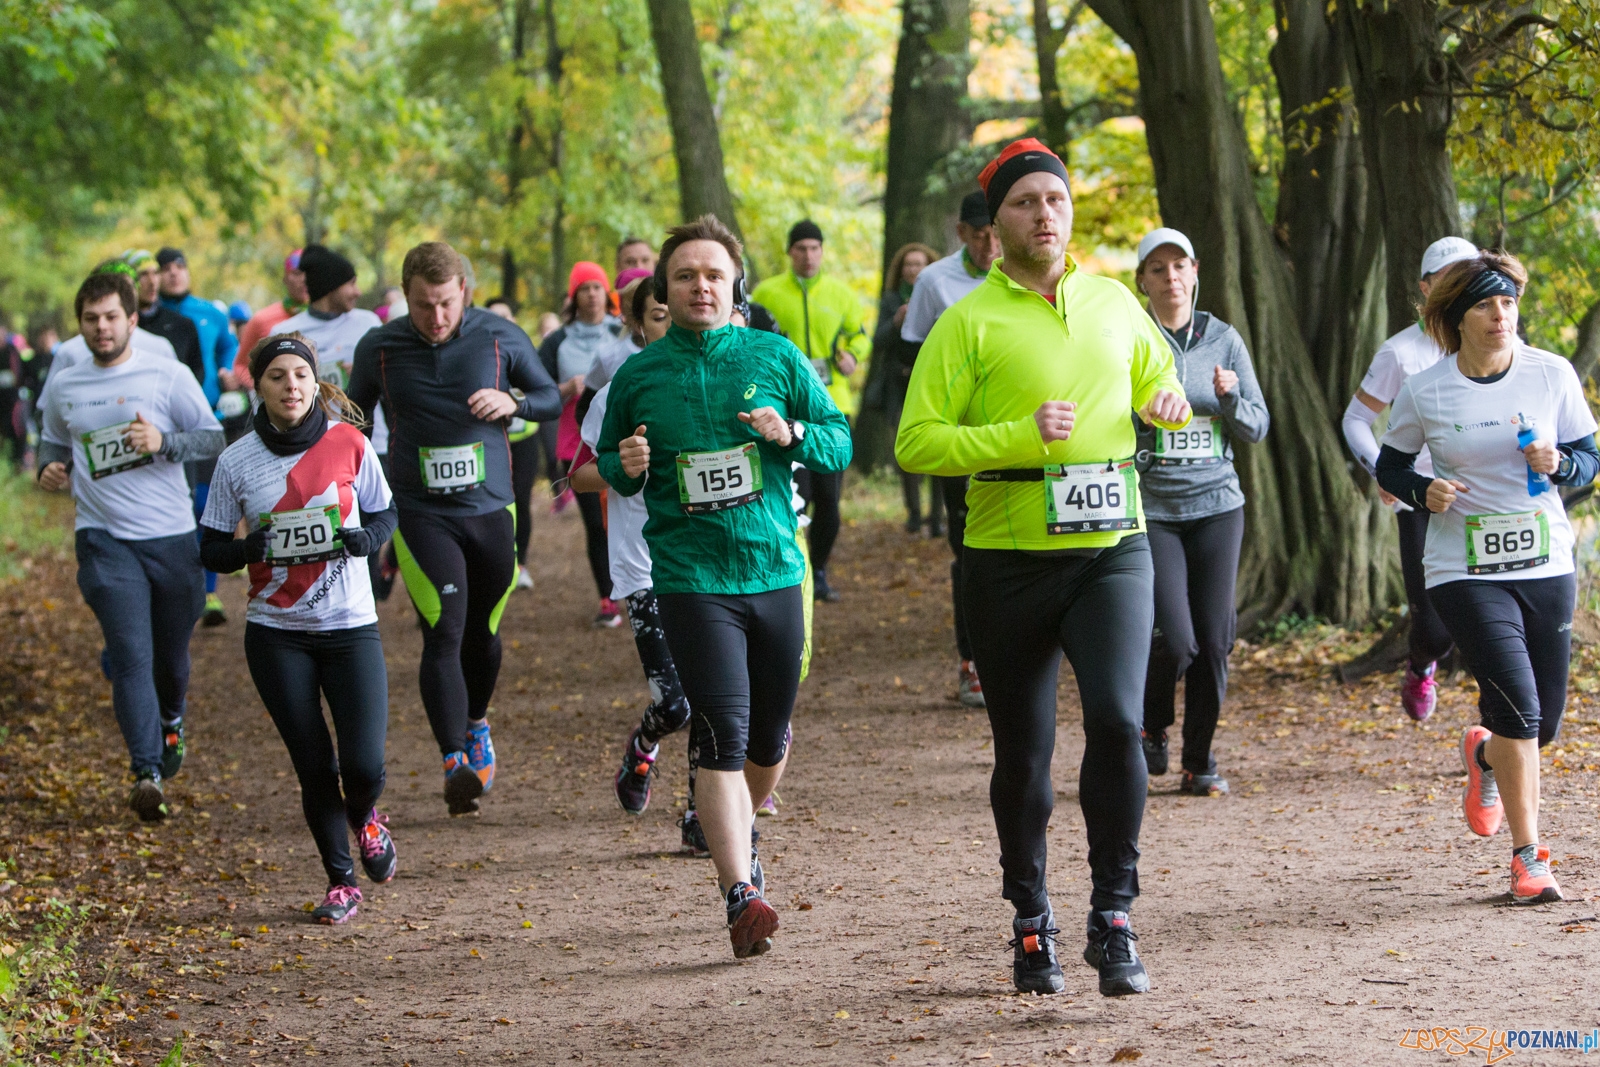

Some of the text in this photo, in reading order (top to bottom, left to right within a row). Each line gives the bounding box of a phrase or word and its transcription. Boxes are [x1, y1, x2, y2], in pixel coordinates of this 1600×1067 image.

[1168, 431, 1211, 450] 1393
[430, 459, 475, 480] 1081
[697, 465, 743, 492] 155
[713, 492, 734, 500] TOMEK
[1065, 482, 1120, 510] 406
[1084, 511, 1107, 519] MAREK
[277, 523, 327, 549] 750
[1484, 529, 1534, 555] 869
